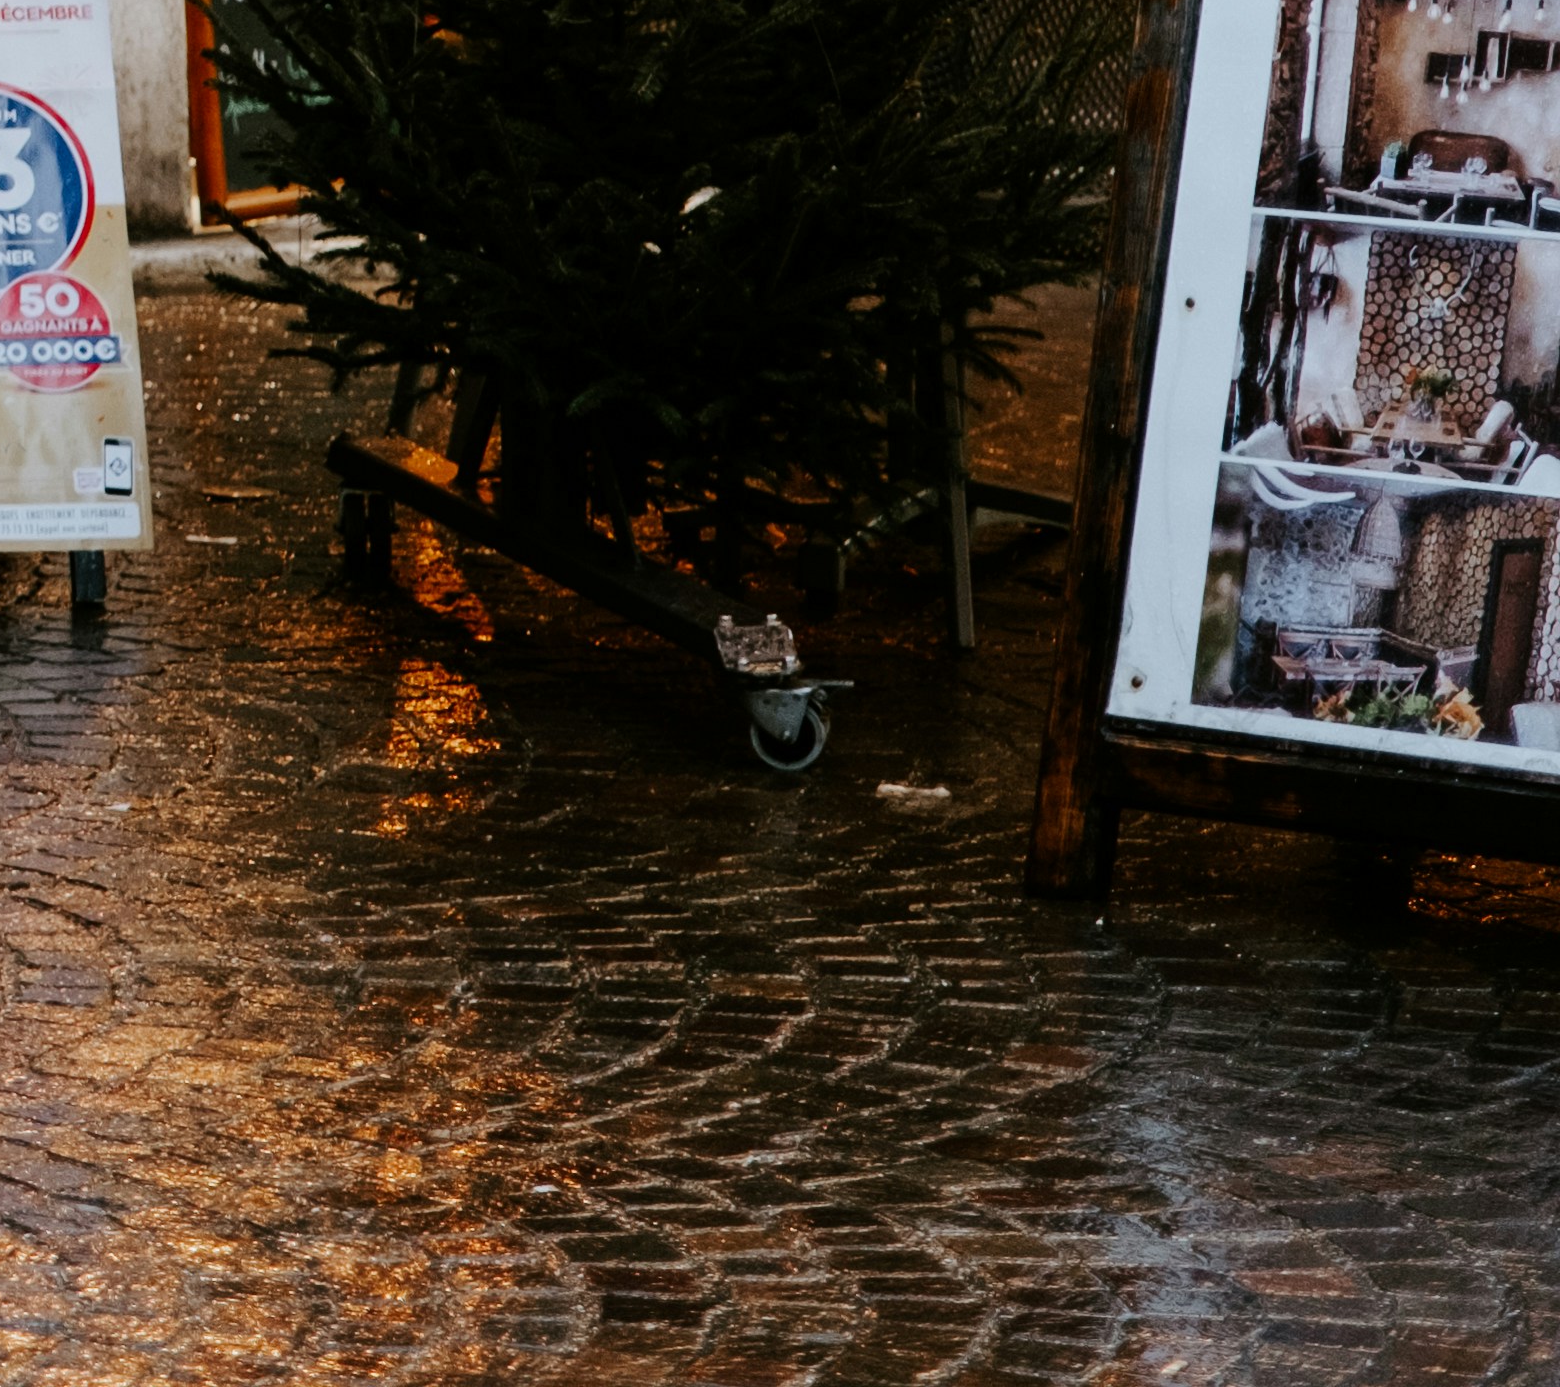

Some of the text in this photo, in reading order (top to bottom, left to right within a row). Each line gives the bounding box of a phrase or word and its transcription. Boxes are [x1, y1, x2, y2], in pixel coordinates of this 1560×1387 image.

[19, 281, 81, 319] 50
[0, 314, 104, 335] GAGNANTS À
[31, 338, 117, 363] 000€
